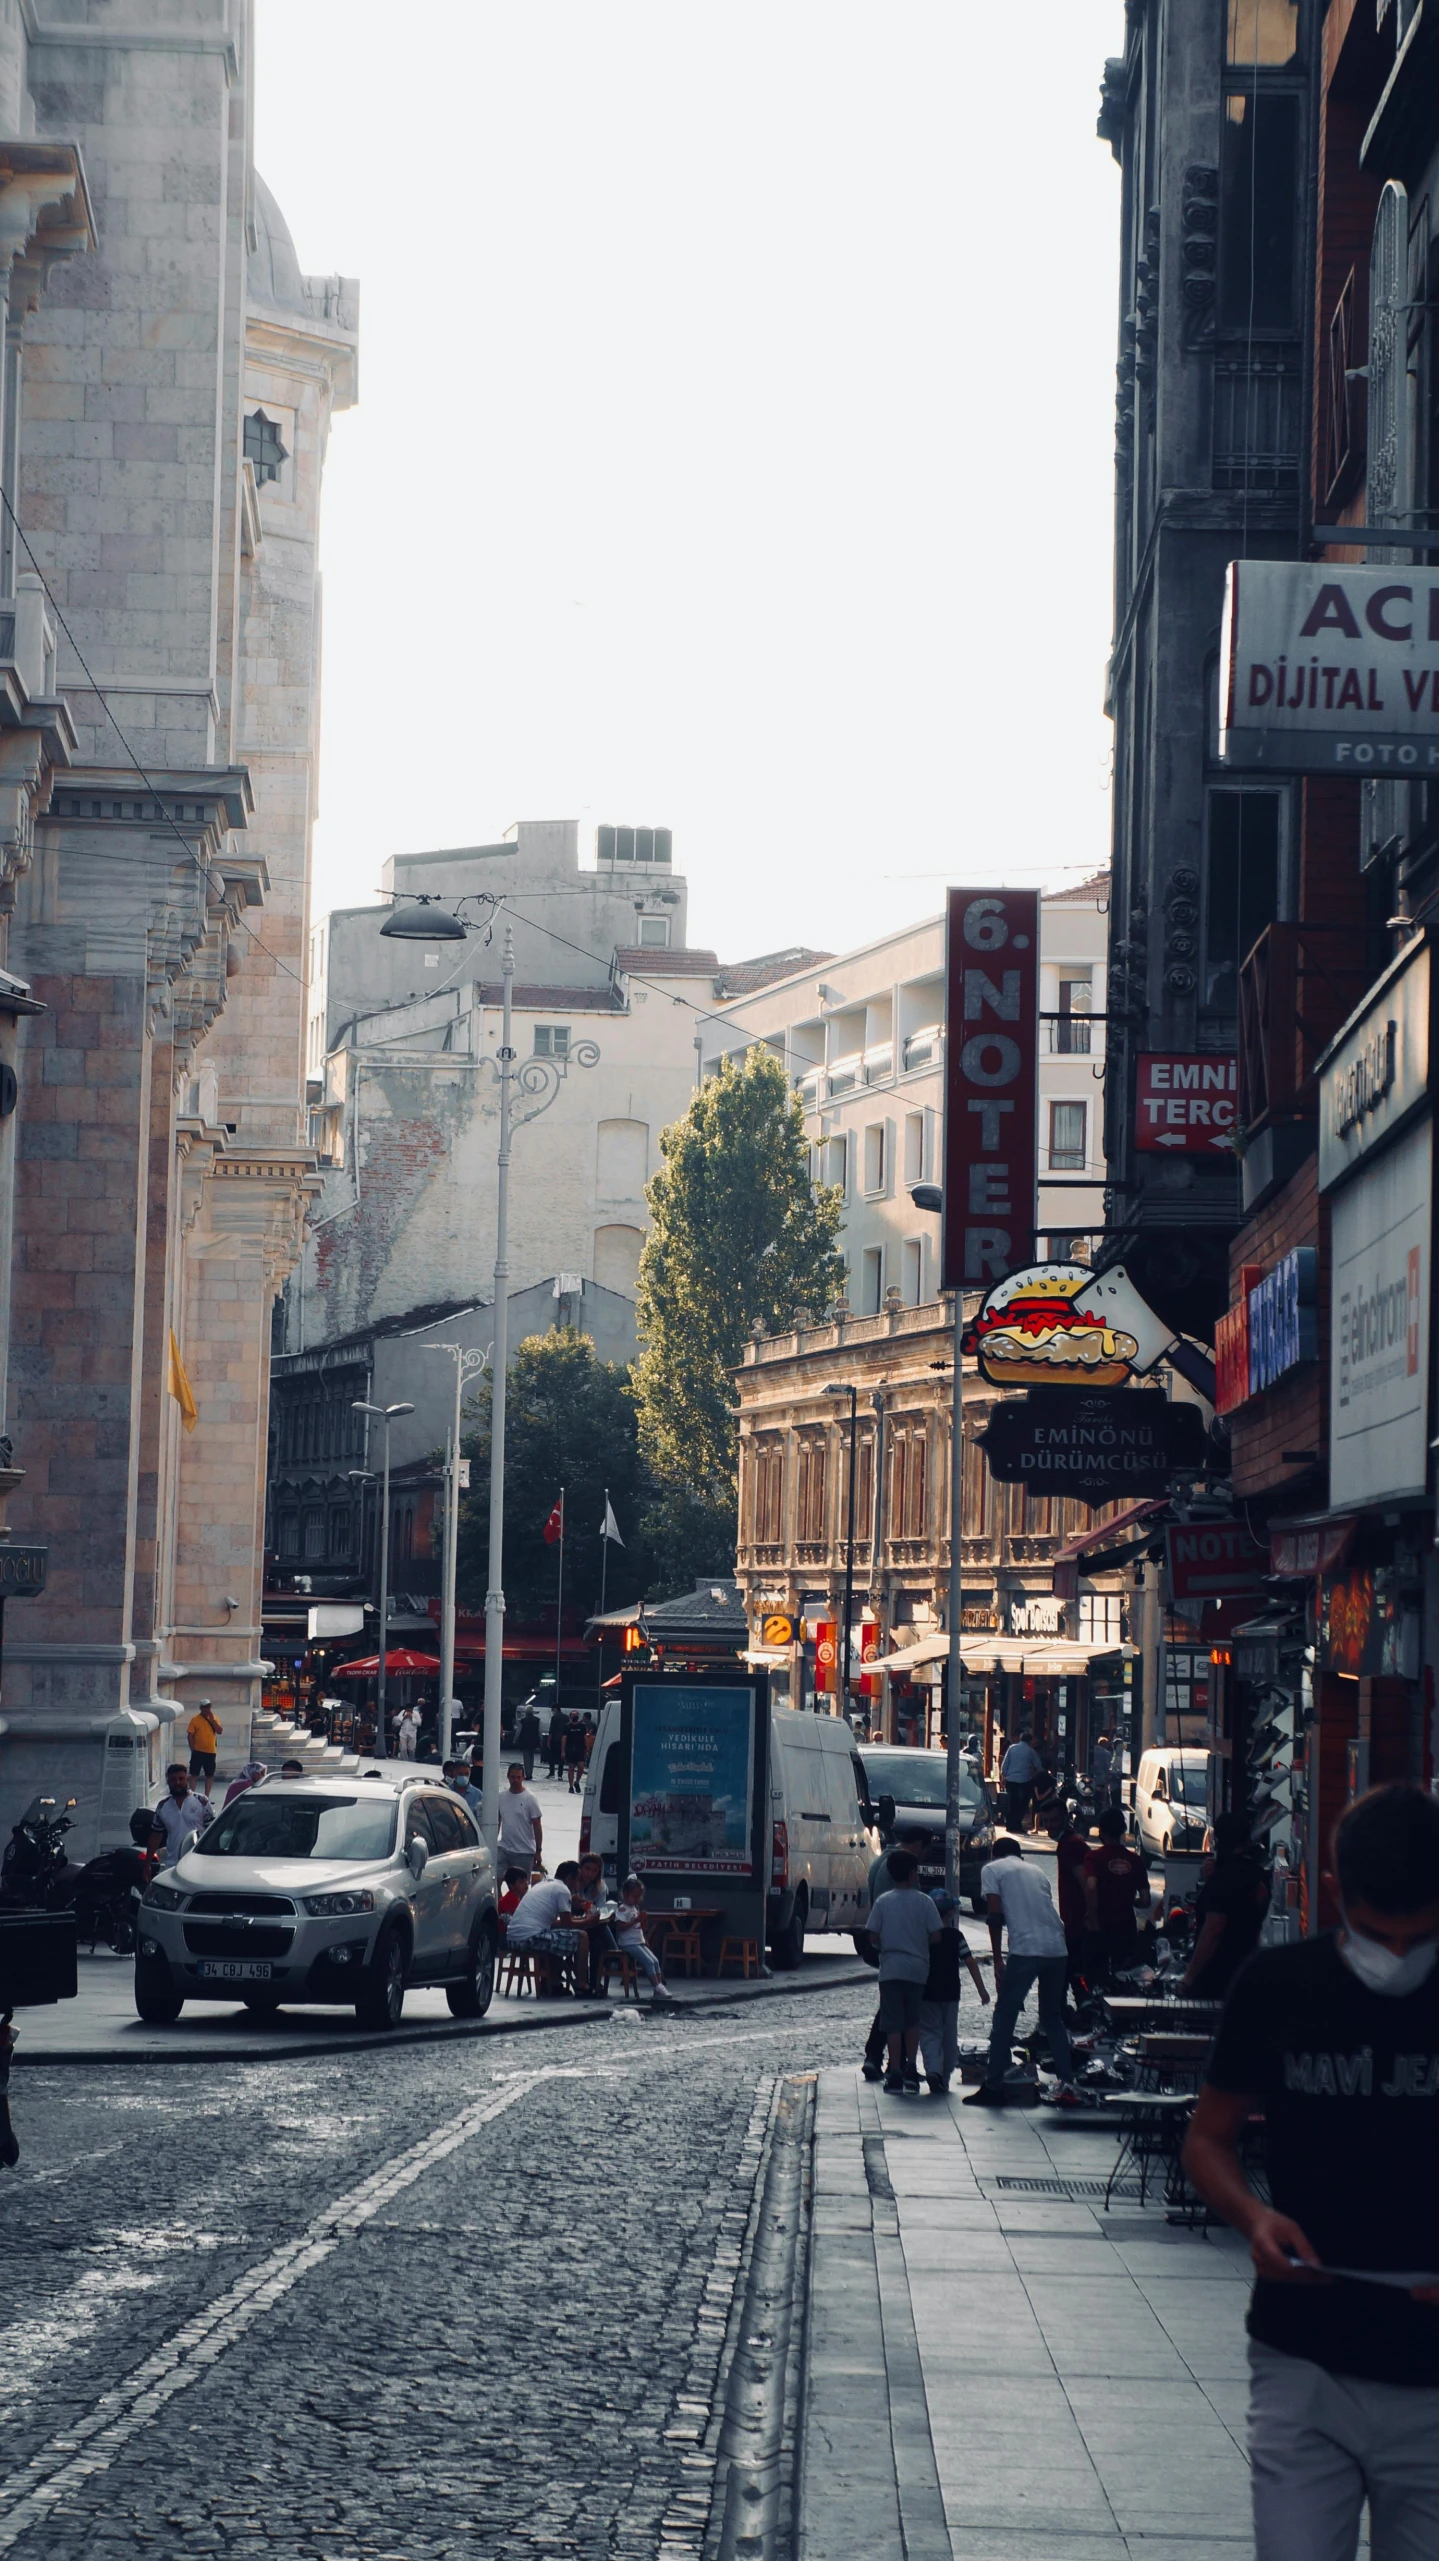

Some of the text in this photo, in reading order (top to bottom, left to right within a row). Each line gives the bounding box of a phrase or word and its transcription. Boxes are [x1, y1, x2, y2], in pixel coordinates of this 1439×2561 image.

[1299, 584, 1439, 642] AC
[1248, 655, 1384, 711] DİJİTAL
[1335, 743, 1418, 764] FOTO
[1151, 1059, 1237, 1091] EMNİ
[960, 898, 1031, 1280] 6. NOTER
[1143, 1098, 1235, 1126] TERC
[1034, 1425, 1154, 1446] EMİNÖNÜ
[1020, 1450, 1167, 1470] DÜRÜMCÜSÜ
[0, 1550, 45, 1584] OĞLU
[661, 1742, 719, 1752] HİSARI'NDA
[668, 1733, 716, 1743] YEDİKULE
[651, 1860, 742, 1871] FATİH BELEDİYESİ
[205, 1963, 269, 1978] 34 CBJ 496
[1284, 2046, 1374, 2096] MAVİ
